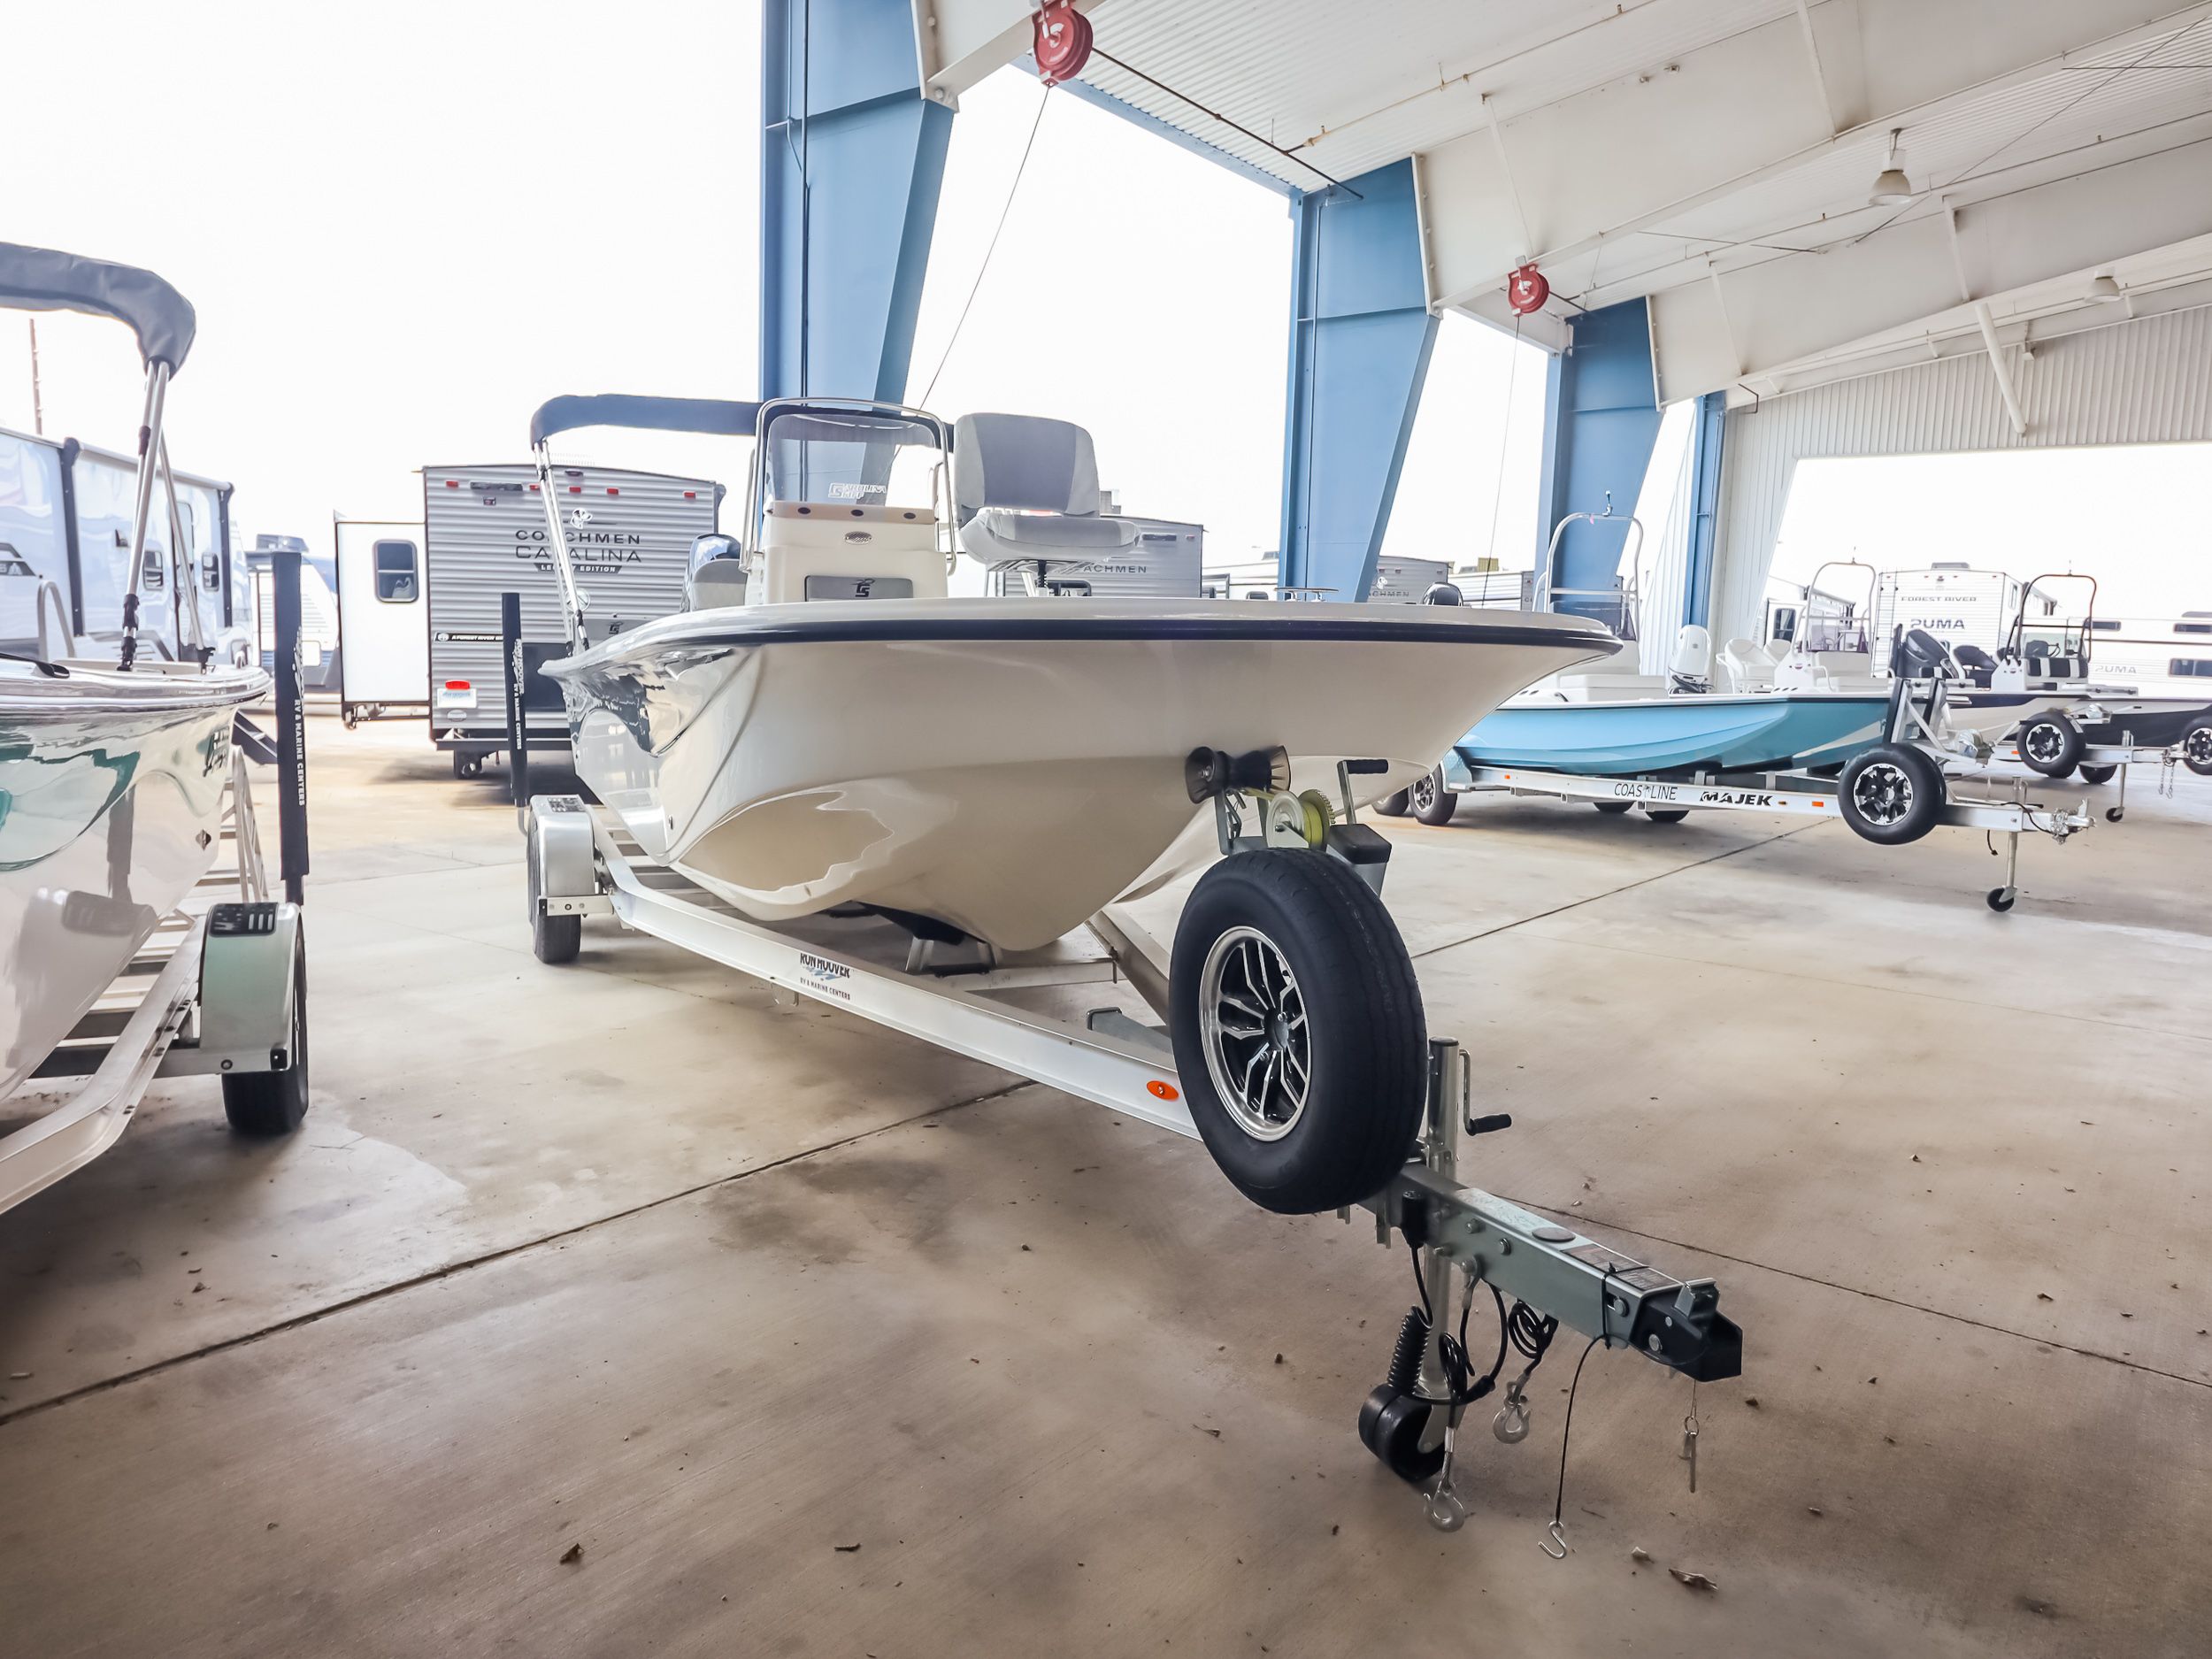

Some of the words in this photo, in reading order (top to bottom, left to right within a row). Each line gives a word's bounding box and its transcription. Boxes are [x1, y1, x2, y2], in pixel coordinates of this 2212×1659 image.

[515, 530, 640, 544] COCHMEN
[516, 545, 641, 562] CAALINA
[1083, 565, 1147, 573] ACHMEN
[294, 699, 301, 711] RV
[295, 723, 303, 760] MARINE
[296, 762, 305, 807] CENTERS
[1700, 791, 1773, 807] MAJEK
[810, 981, 828, 994] MARINE
[829, 987, 850, 1001] CENTERS
